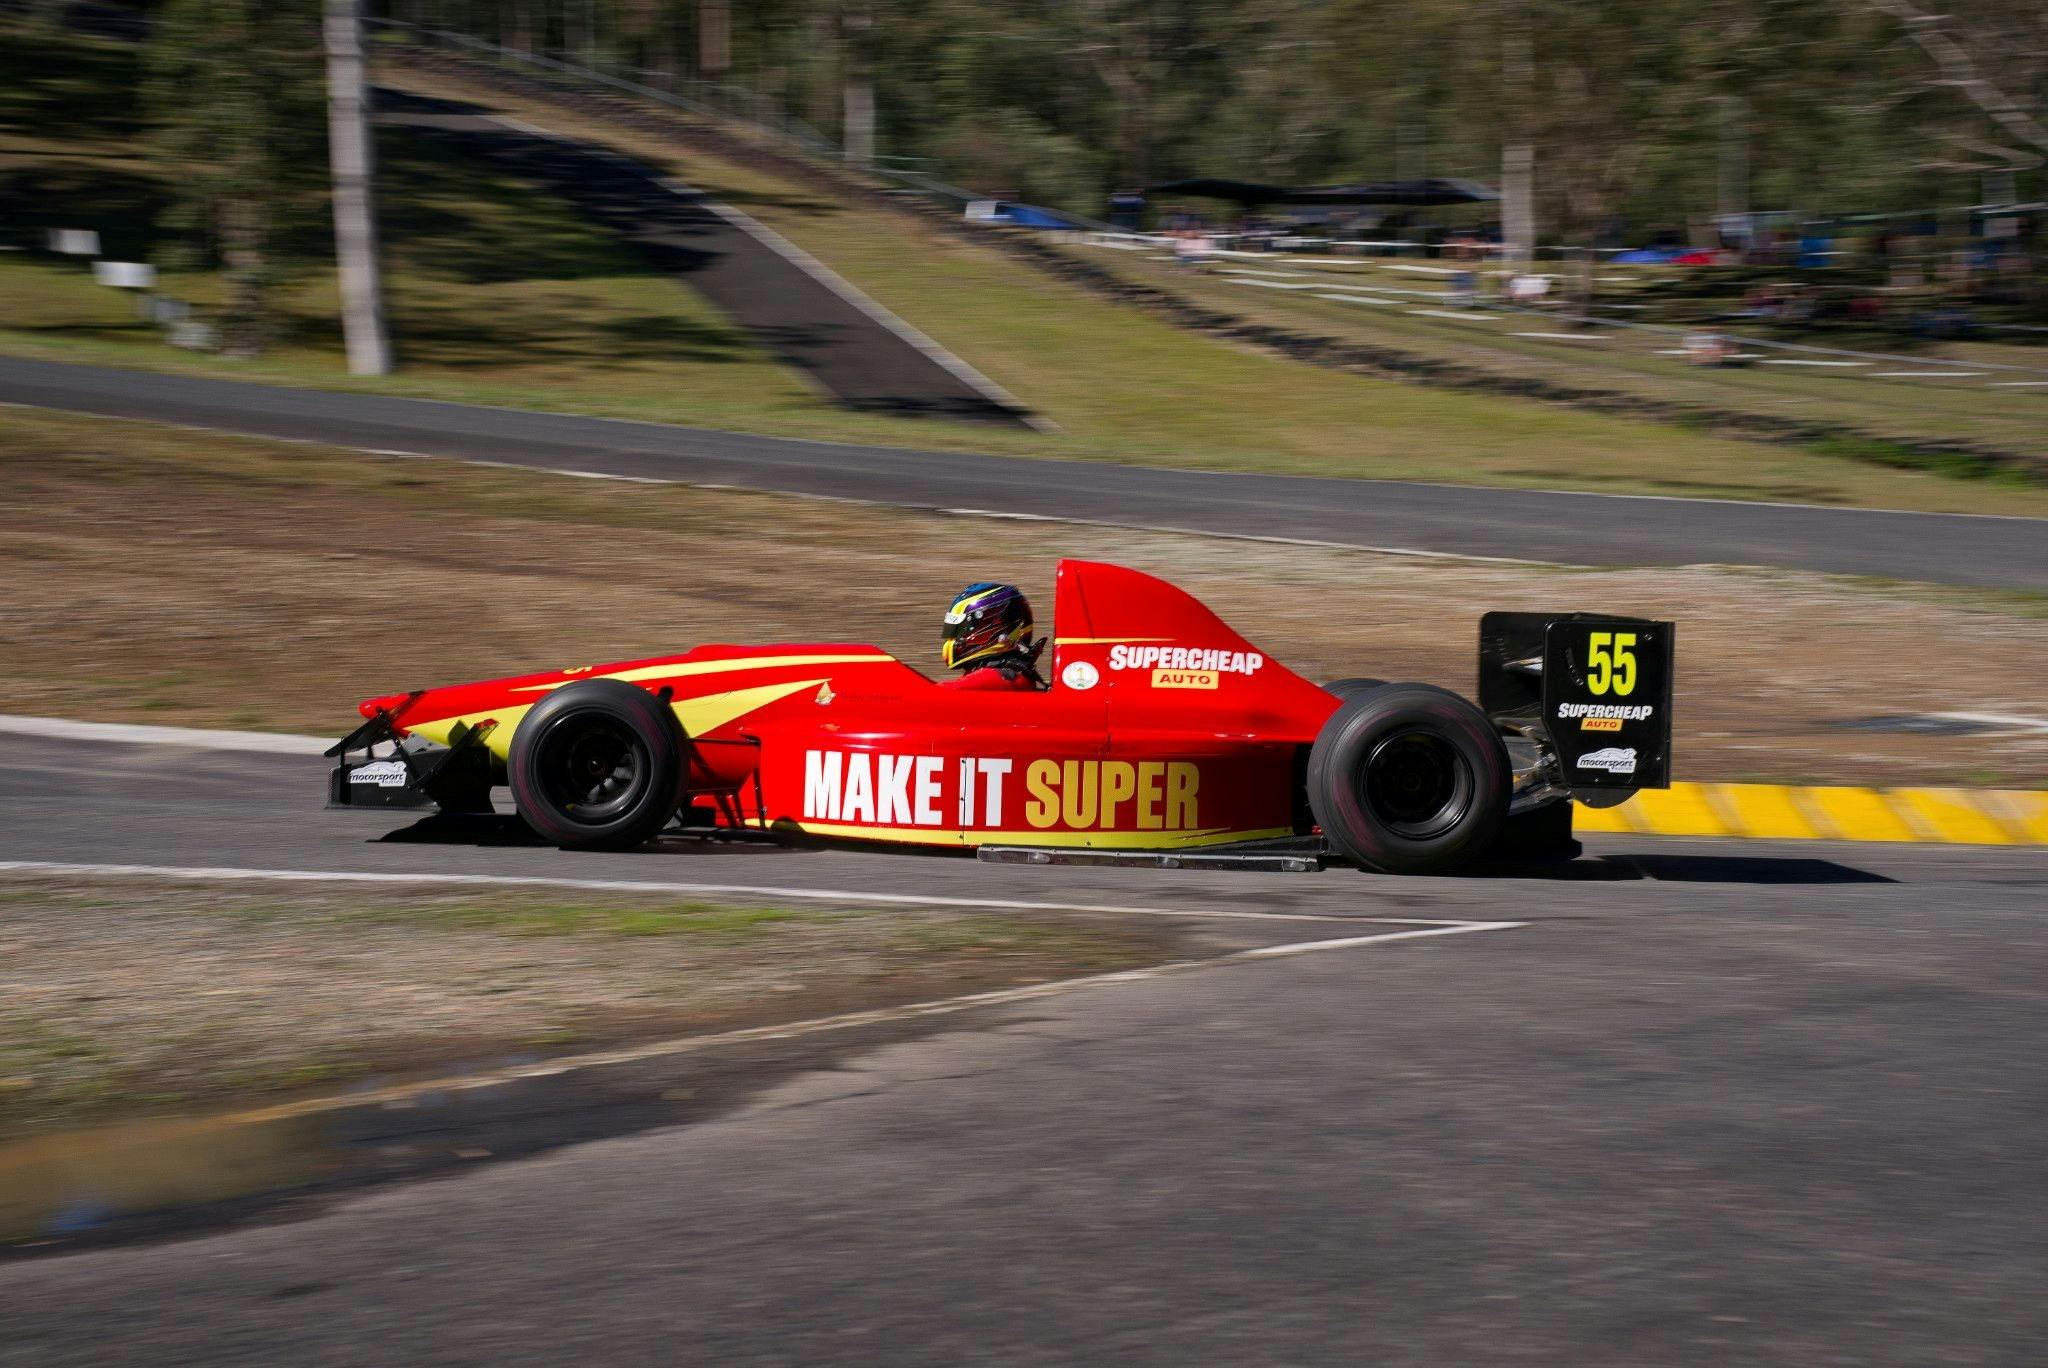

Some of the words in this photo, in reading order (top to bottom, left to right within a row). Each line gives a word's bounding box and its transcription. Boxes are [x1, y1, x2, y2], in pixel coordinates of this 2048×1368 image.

[1109, 644, 1264, 676] SUPERCHEAP
[1587, 632, 1637, 696] 55
[1160, 674, 1211, 685] AUTO
[1557, 702, 1654, 721] SUPERCHEAP
[1585, 720, 1617, 728] AUTO
[1580, 760, 1633, 769] motorsport
[803, 749, 944, 826] MAKE
[958, 757, 1013, 827] IT
[1025, 758, 1201, 829] SUPER
